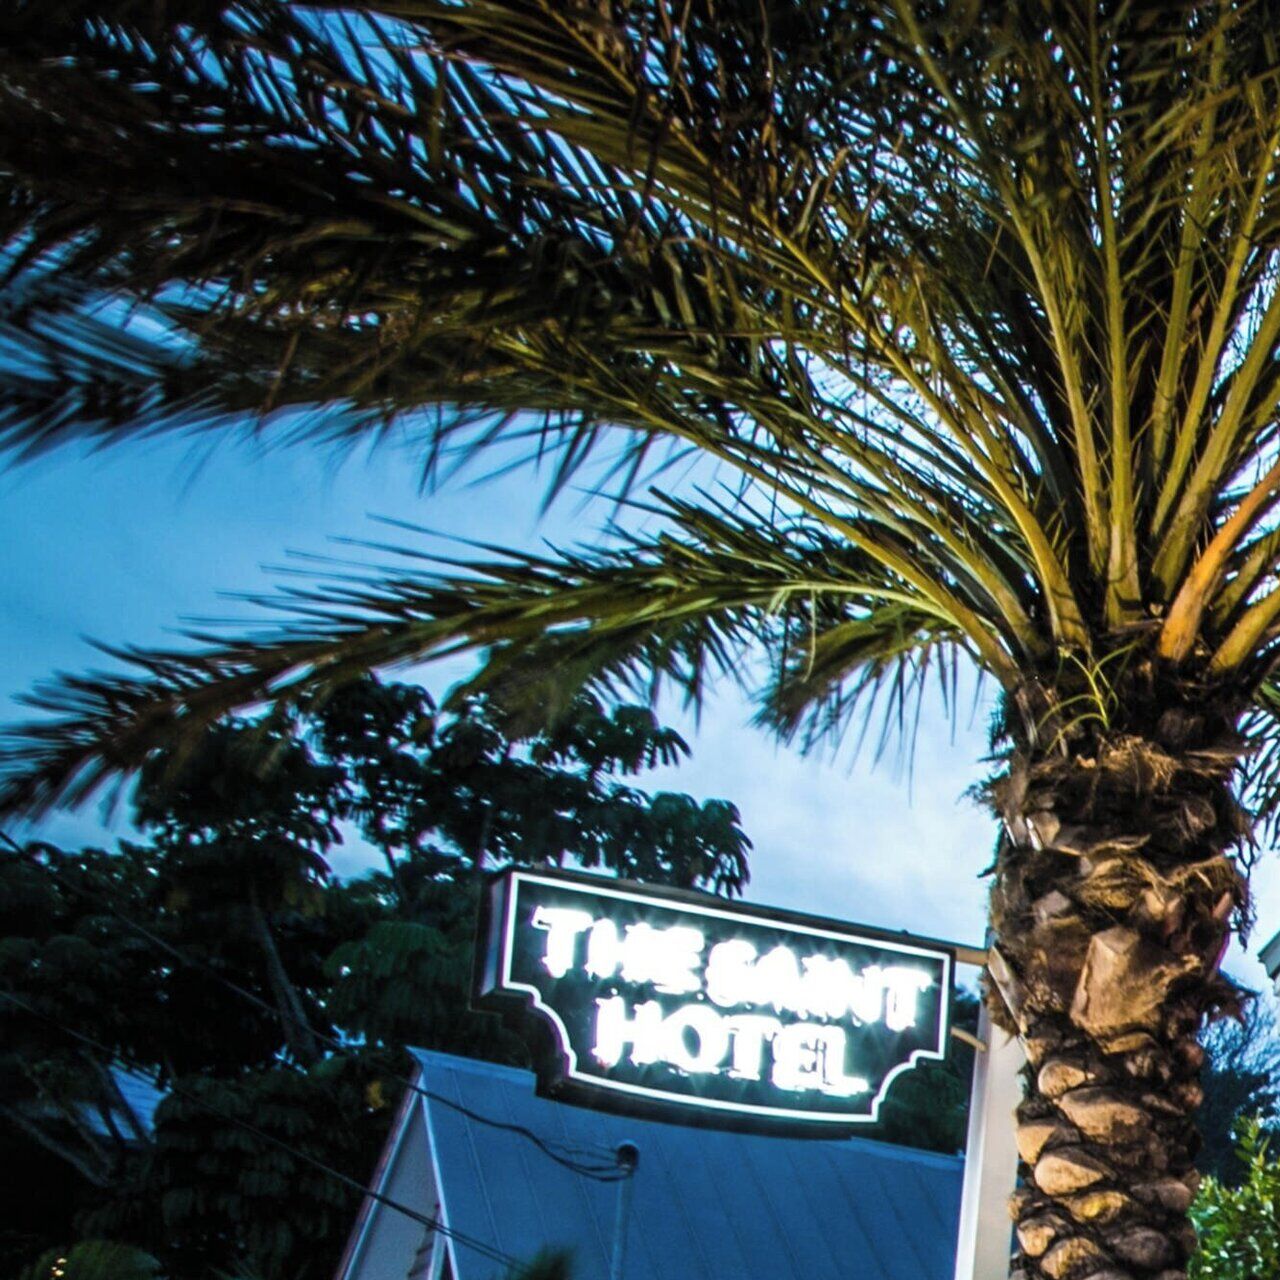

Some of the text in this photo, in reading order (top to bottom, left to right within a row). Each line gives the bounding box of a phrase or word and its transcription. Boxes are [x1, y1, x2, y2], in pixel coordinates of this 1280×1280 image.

[531, 905, 933, 1031] THE SAINT
[592, 997, 869, 1096] HOTEL
